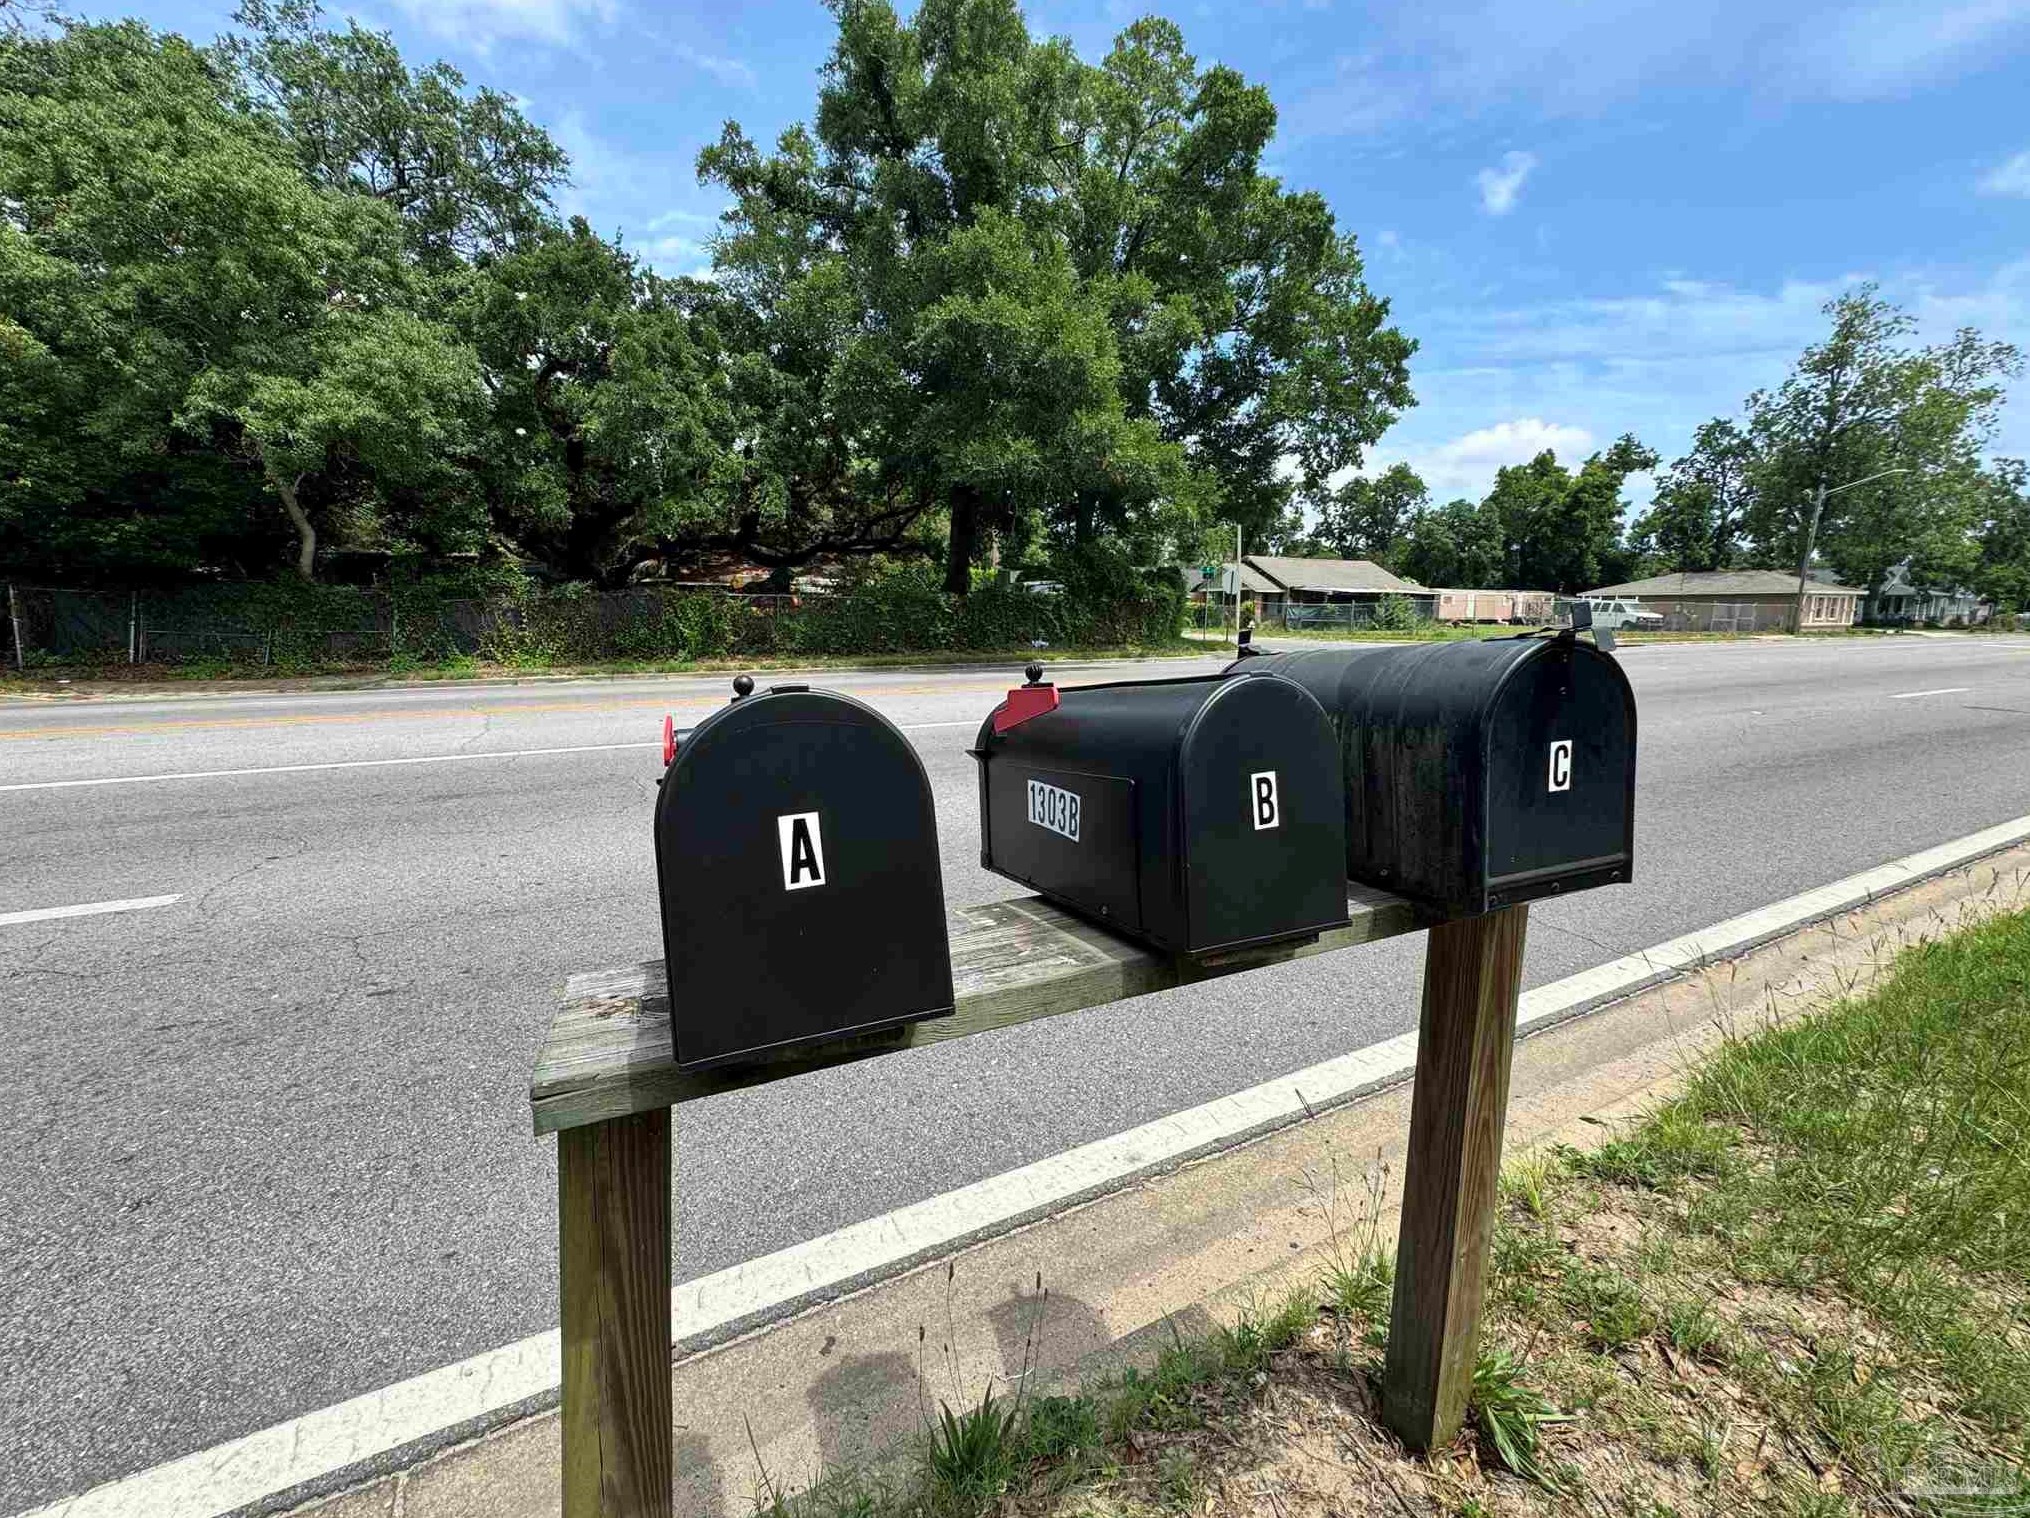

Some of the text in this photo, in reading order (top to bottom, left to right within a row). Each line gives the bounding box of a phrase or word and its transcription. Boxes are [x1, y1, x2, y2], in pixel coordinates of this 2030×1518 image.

[1553, 744, 1569, 787] C
[1030, 782, 1079, 837] 1303B
[1256, 776, 1275, 825] B
[790, 818, 822, 884] A
